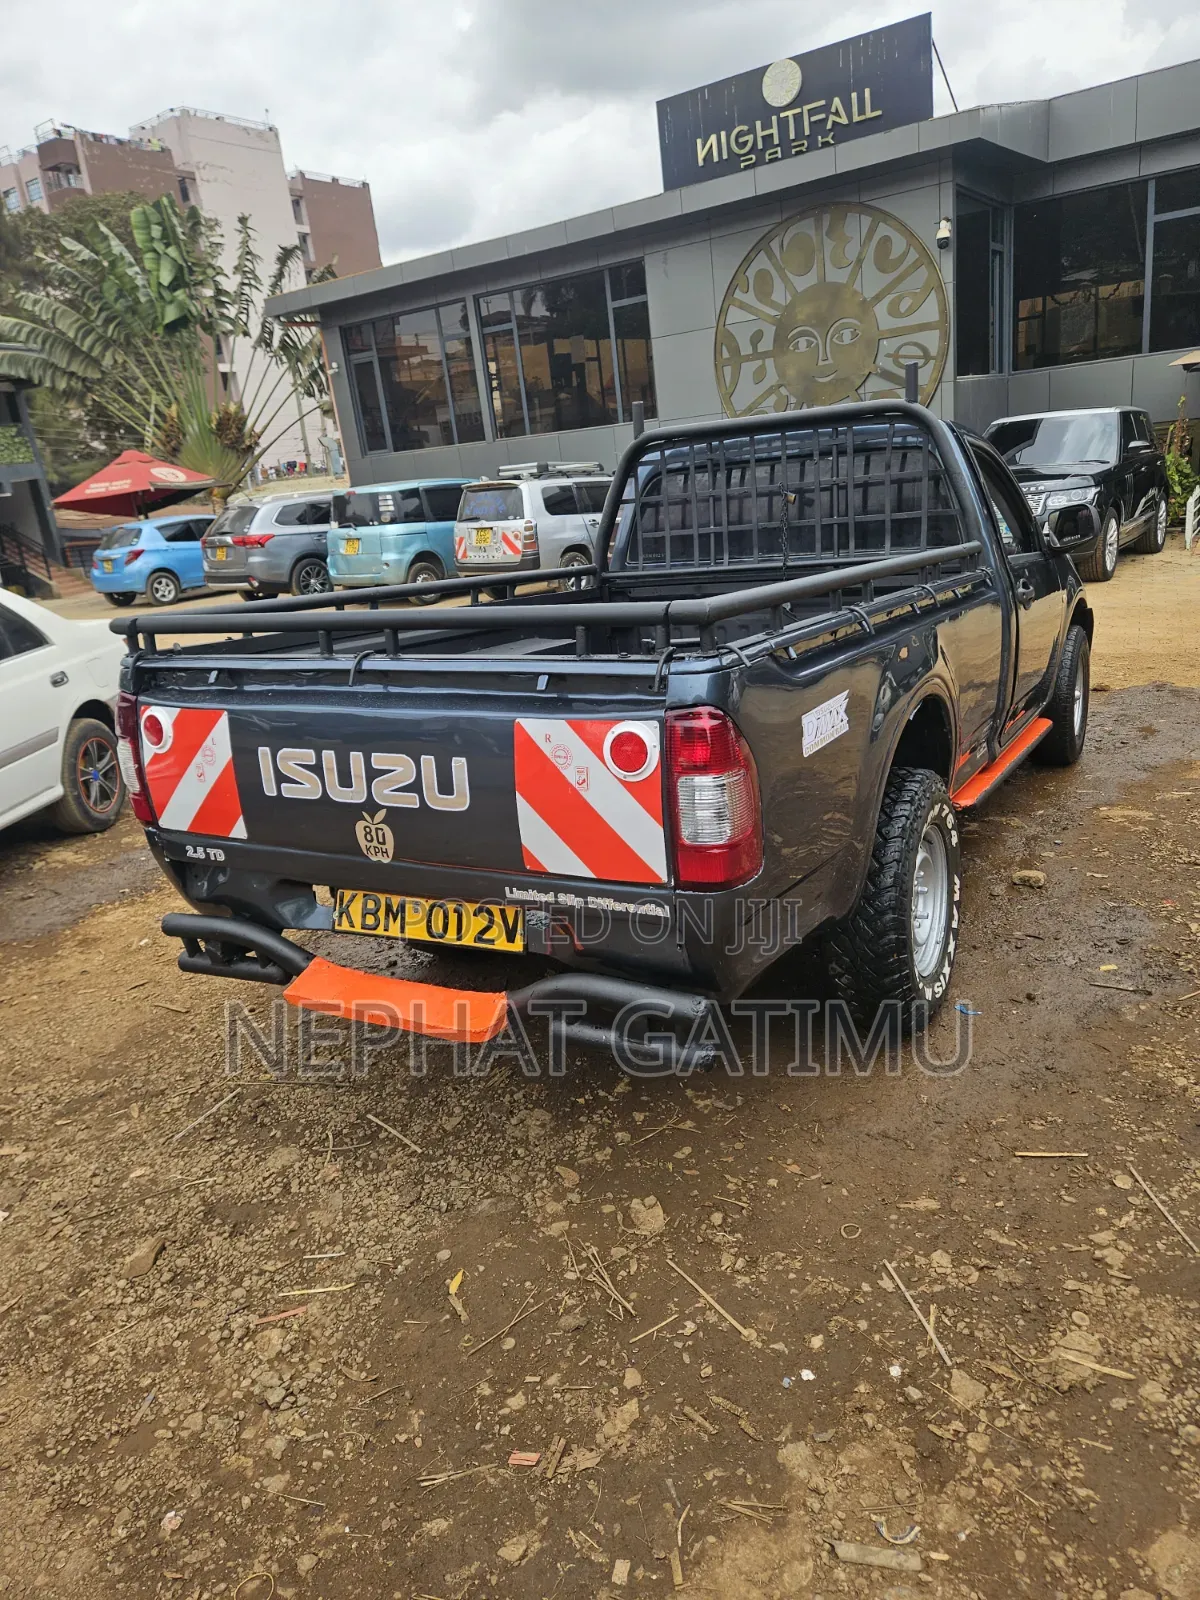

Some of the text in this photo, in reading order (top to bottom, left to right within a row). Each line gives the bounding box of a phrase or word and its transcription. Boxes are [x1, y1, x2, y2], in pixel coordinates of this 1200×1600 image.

[696, 87, 883, 167] NIGHTFALL
[740, 132, 835, 169] PARK
[545, 733, 552, 743] R
[258, 747, 470, 811] ISUZU
[363, 825, 387, 846] 80
[365, 844, 390, 859] KPH
[206, 847, 225, 861] TD
[504, 886, 671, 918] Limited Slip Differential
[337, 891, 521, 946] KBM 012V
